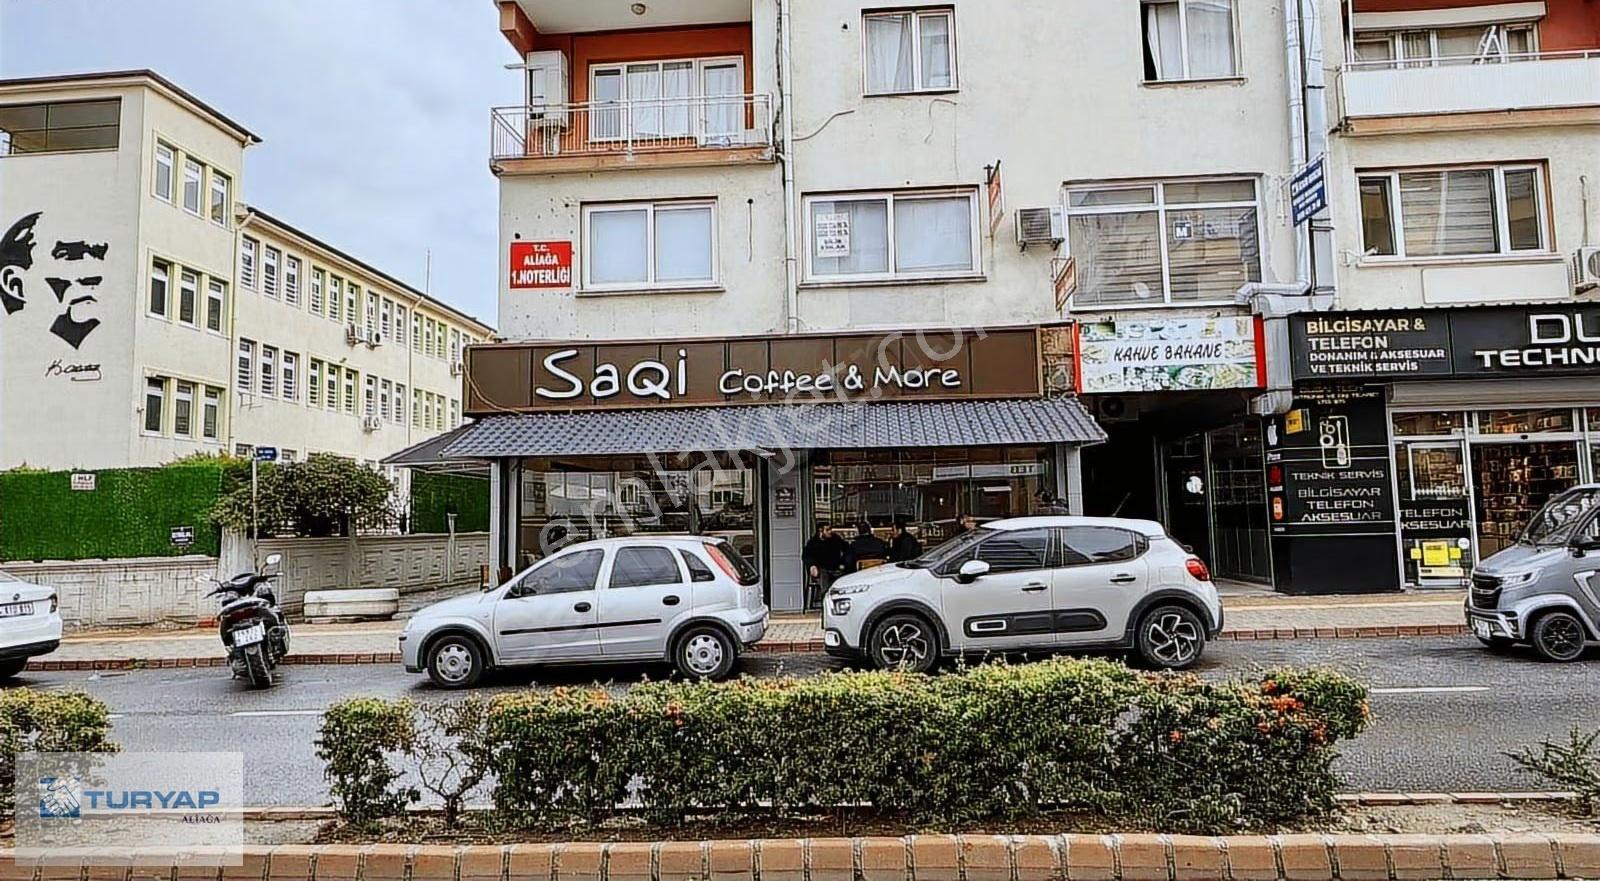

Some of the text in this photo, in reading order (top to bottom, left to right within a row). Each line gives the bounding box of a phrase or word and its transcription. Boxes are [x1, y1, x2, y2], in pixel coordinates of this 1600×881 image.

[523, 252, 559, 266] ALİAĞA
[1306, 317, 1426, 334] BİLGİSAYAR &
[1307, 336, 1388, 350] TELEFON
[1164, 343, 1223, 360] BAHANE
[1309, 351, 1368, 362] DONANIM
[1380, 349, 1446, 360] AKSESUAR
[1474, 347, 1600, 367] TECHN
[1310, 360, 1419, 374] VE TEKNİK SERVİS
[719, 368, 834, 394] Coffee
[844, 365, 864, 390] &
[873, 365, 961, 388] More
[1338, 469, 1385, 480] SERVİS
[1298, 486, 1382, 498] BİLGİSAYAR
[1306, 500, 1375, 510] TELEFON
[1301, 511, 1382, 522] AKSESUAR
[1400, 520, 1472, 530] KSESUAR
